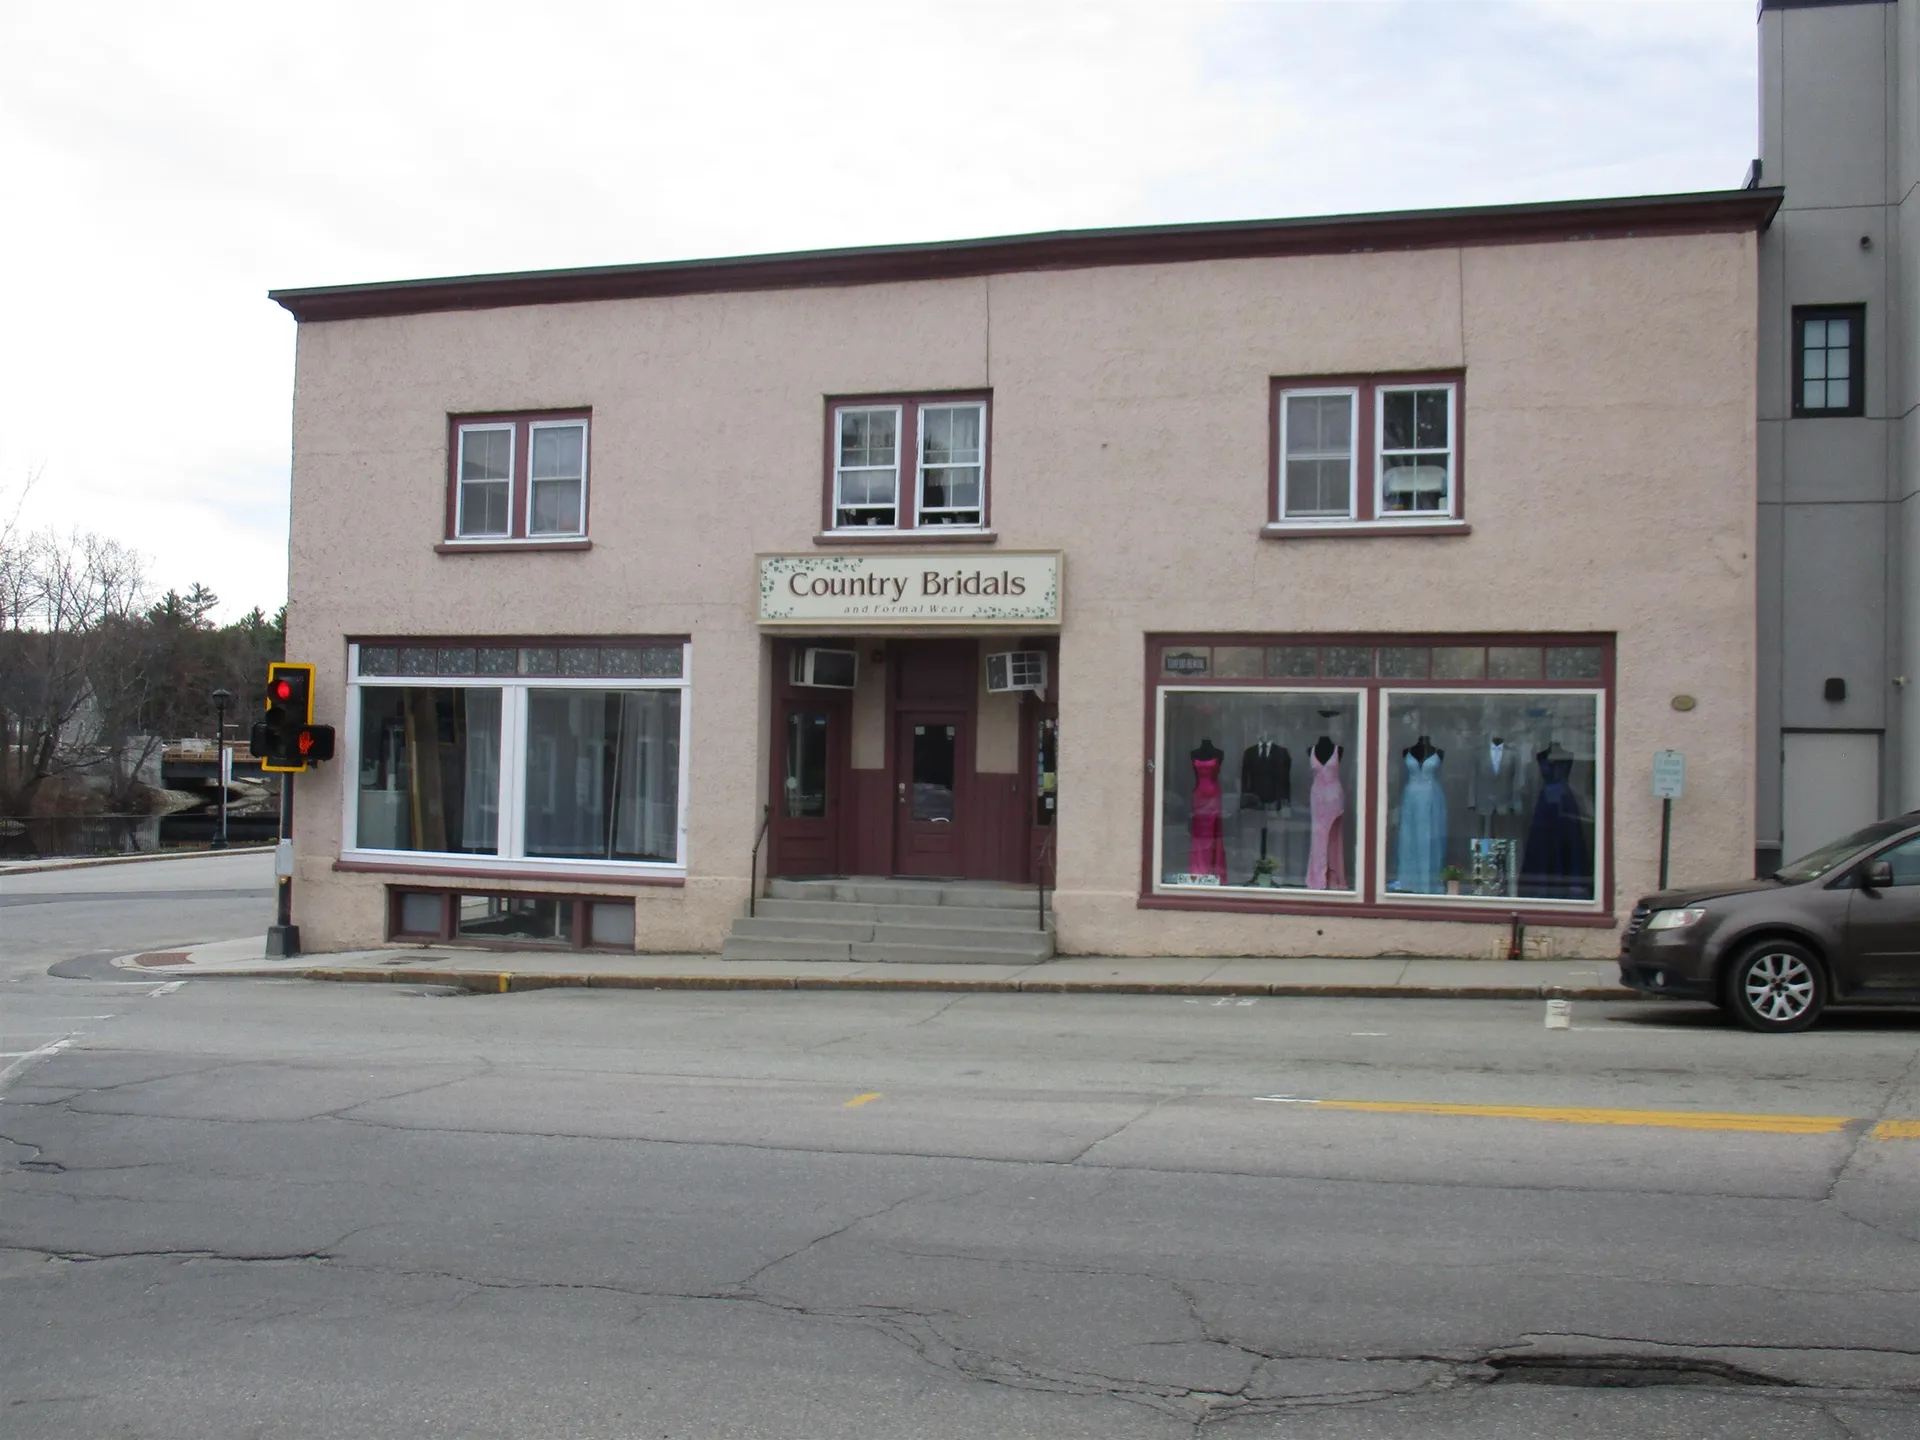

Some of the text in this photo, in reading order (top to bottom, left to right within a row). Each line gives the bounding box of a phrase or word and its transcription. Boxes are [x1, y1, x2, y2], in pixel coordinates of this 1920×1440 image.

[788, 570, 1027, 602] Country Bridals
[843, 604, 965, 614] and Formal Wear
